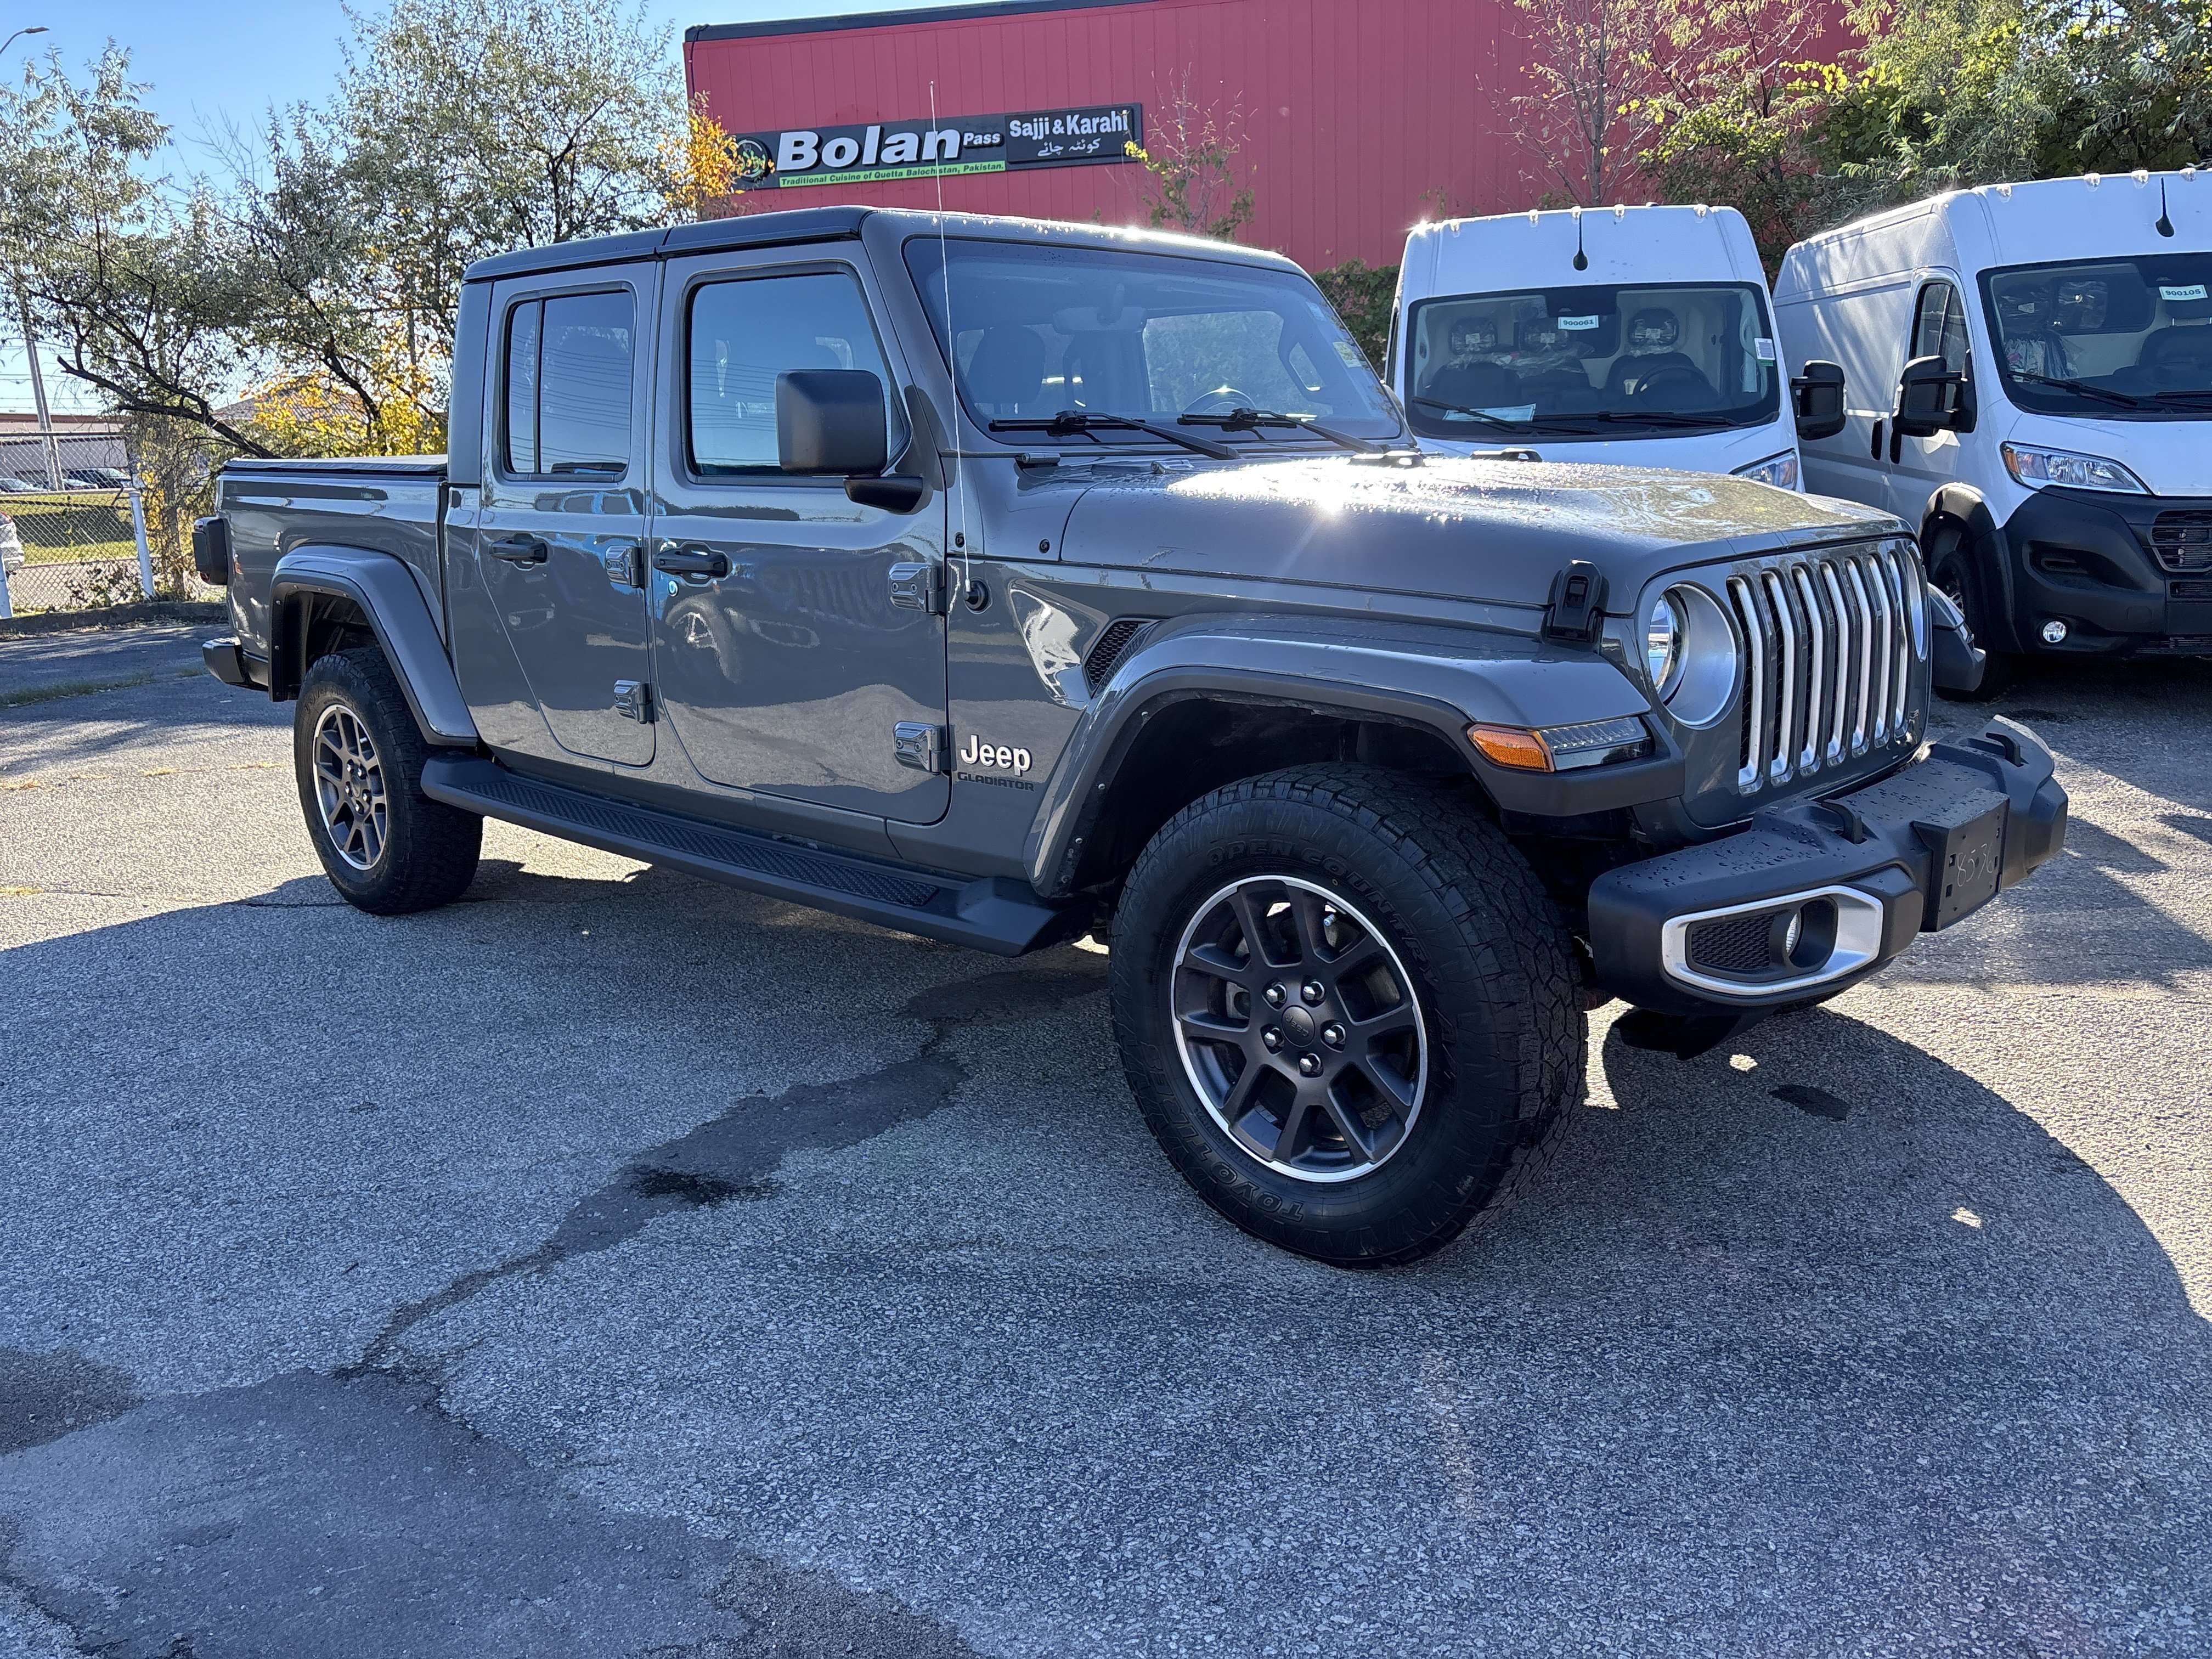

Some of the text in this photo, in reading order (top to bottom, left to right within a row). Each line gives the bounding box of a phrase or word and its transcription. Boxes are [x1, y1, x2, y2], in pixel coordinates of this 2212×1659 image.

[1009, 110, 1128, 140] Sajji & Karahi
[776, 125, 960, 171] Bolan
[963, 132, 1001, 146] Pass
[781, 175, 827, 185] Traditional
[830, 173, 861, 182] Cuisine
[864, 171, 872, 179] of
[874, 170, 903, 179] Quetta
[963, 163, 1004, 173] Pakistan.
[961, 734, 1032, 777] Jeep
[957, 771, 1035, 792] GLADIATOR
[1206, 838, 1295, 867] OPEN
[1285, 1015, 1310, 1037] Jeep
[1210, 1161, 1305, 1223] TOYO
